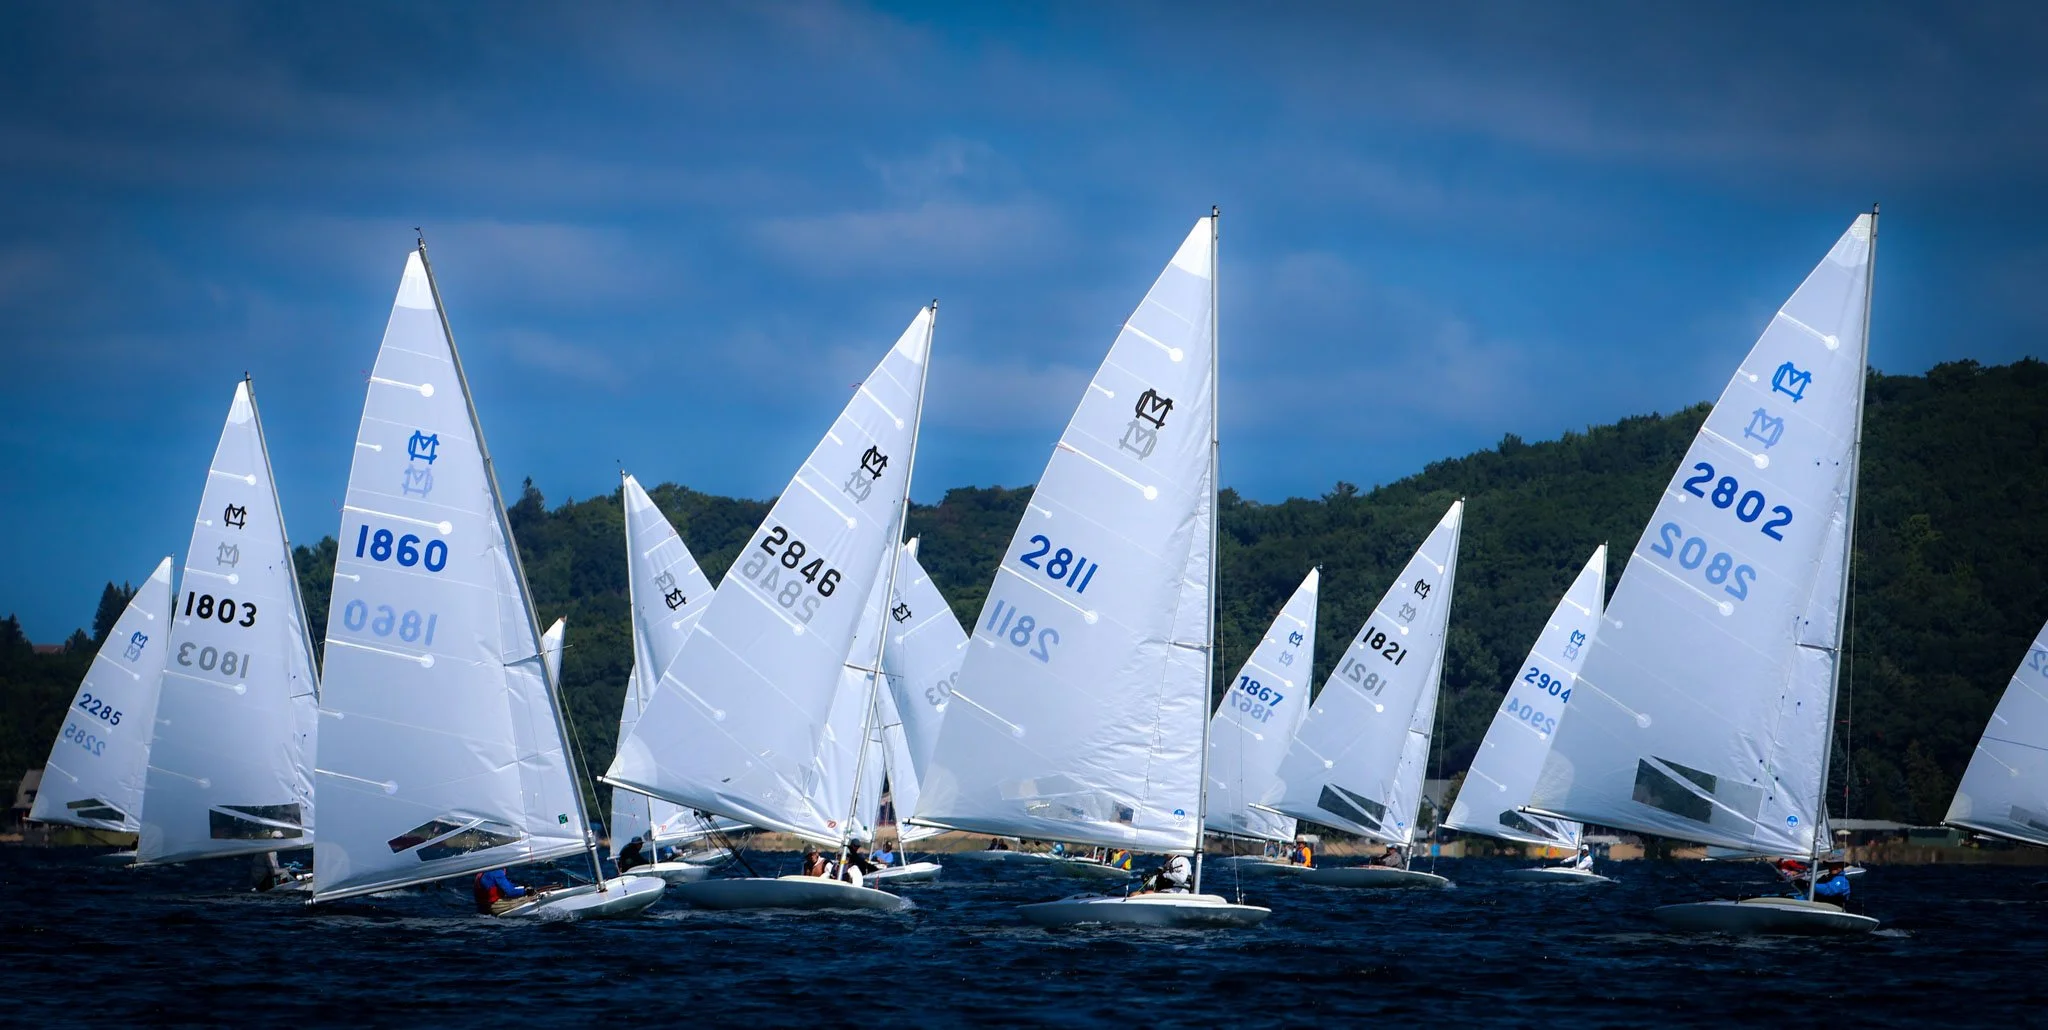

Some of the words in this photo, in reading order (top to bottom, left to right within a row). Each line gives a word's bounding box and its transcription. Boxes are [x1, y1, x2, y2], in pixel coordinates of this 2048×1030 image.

[1682, 462, 1793, 542] 2802
[355, 525, 448, 573] 1860
[760, 526, 841, 598] 2846
[1019, 534, 1098, 594] 2811
[185, 591, 257, 627] 1803
[1362, 626, 1407, 666] 1821
[1240, 676, 1284, 707] 1867
[1524, 667, 1572, 704] 2904
[78, 693, 123, 726] 2285
